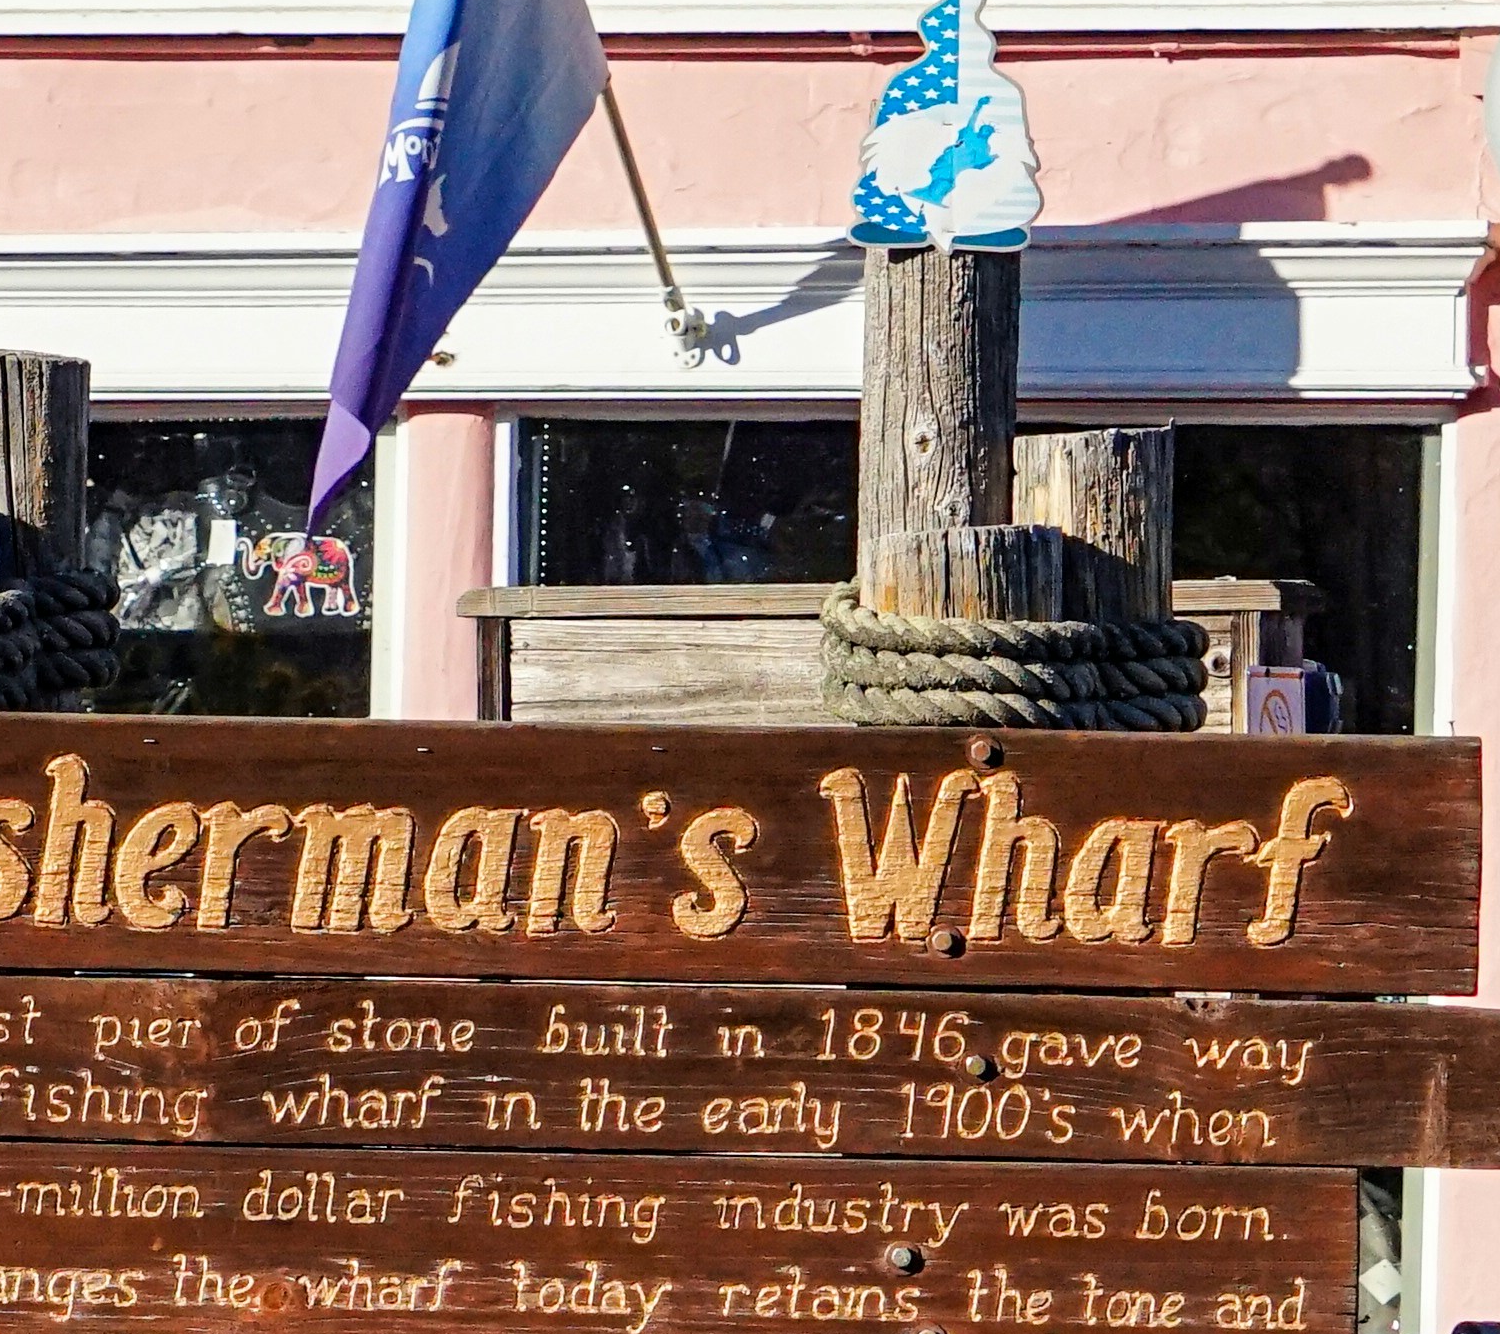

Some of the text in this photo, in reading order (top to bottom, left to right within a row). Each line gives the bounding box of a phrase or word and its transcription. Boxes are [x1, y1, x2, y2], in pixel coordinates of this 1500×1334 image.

[819, 766, 1354, 948] Wharf
[89, 1013, 202, 1060] pier
[235, 998, 299, 1052] of
[327, 1000, 475, 1053] stone
[539, 1004, 674, 1058] built
[716, 1007, 765, 1058] in
[817, 1008, 968, 1062] 1846
[1002, 1031, 1143, 1078] gave
[1183, 1036, 1313, 1086] way
[262, 1073, 445, 1129] wharf
[481, 1087, 541, 1130] in
[579, 1077, 665, 1133] the
[703, 1082, 841, 1149] early
[900, 1083, 1077, 1144] 1900's
[1111, 1091, 1276, 1149] when
[242, 1169, 404, 1223] dollar
[448, 1175, 666, 1244] fishing
[713, 1182, 968, 1248] industry
[999, 1200, 1108, 1239] was
[1135, 1189, 1289, 1242] born.
[174, 1253, 252, 1309] the
[299, 1258, 462, 1313] wharf
[514, 1259, 672, 1334] today
[718, 1267, 920, 1322] retains
[967, 1264, 1053, 1325] the
[1083, 1273, 1186, 1328] tone
[1216, 1277, 1308, 1331] and
